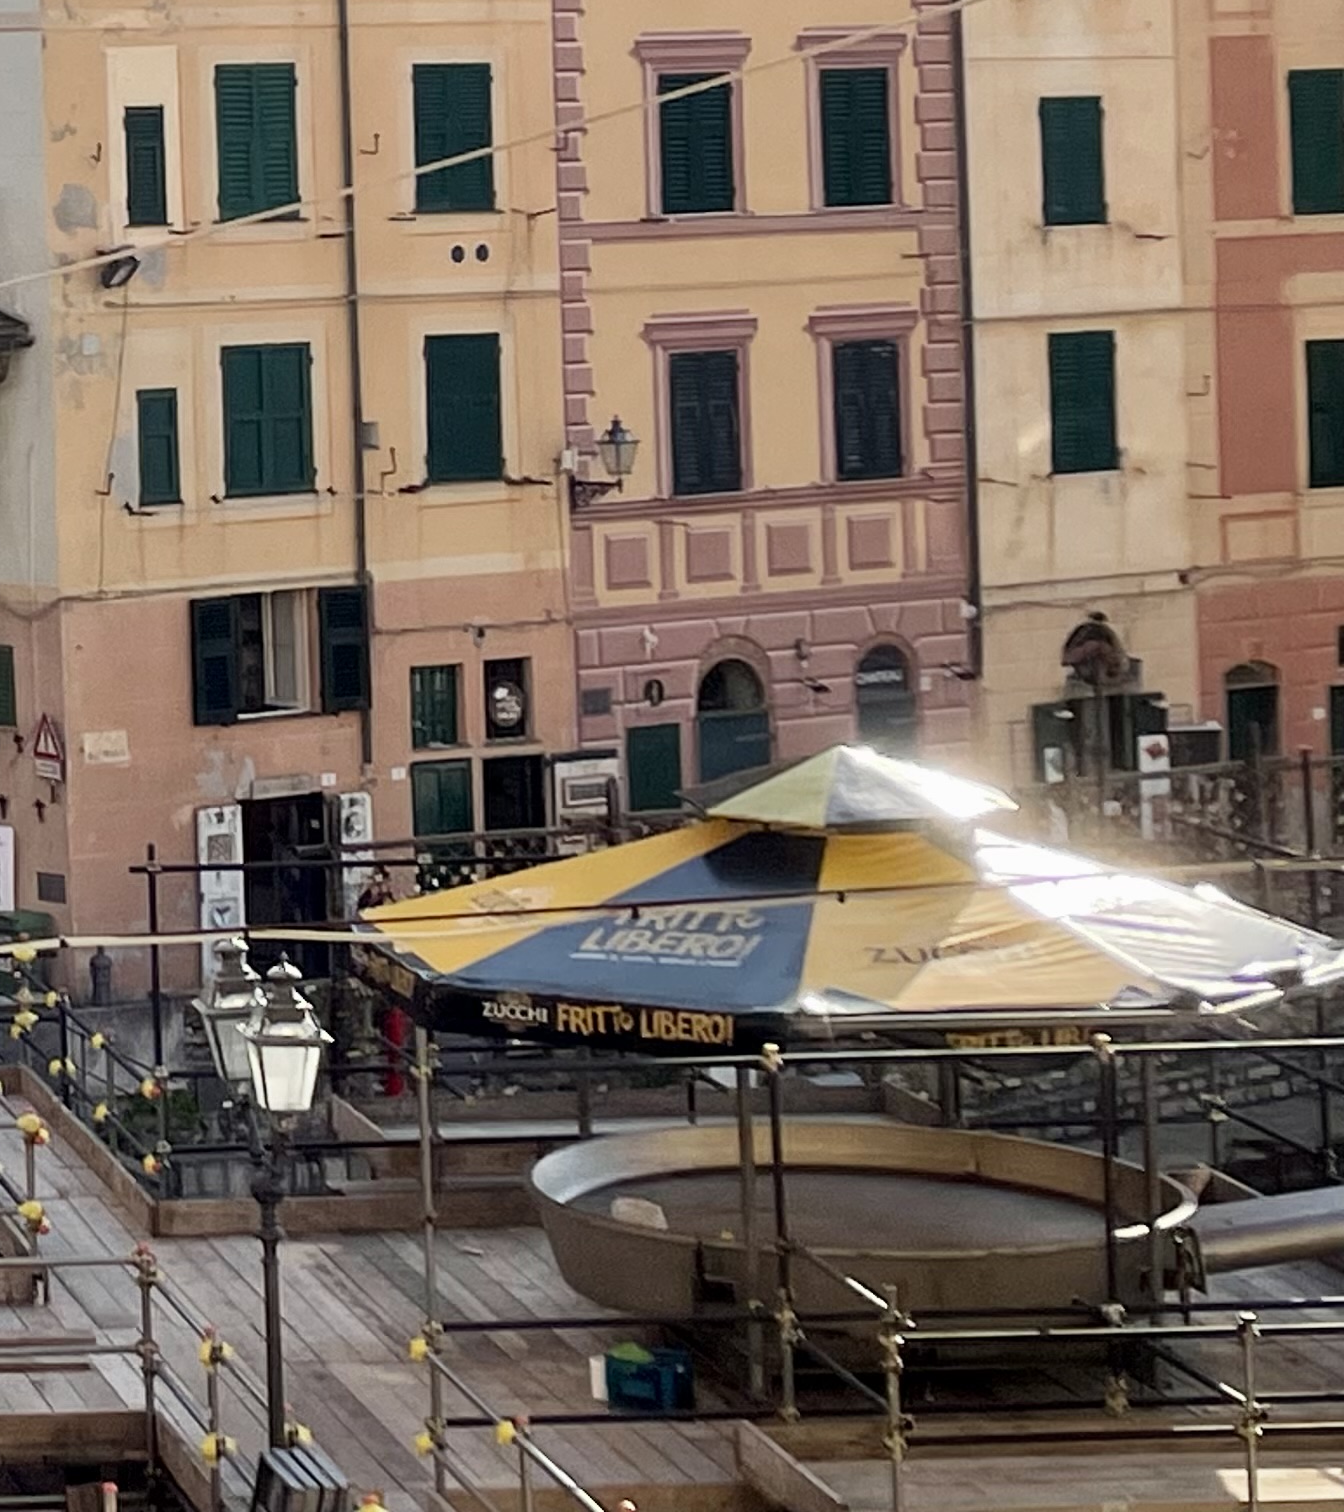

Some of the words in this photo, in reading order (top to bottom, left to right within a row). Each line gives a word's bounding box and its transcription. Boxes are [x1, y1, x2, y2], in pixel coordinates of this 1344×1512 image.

[578, 926, 768, 961] LIBERO!
[481, 1000, 549, 1024] ZUCCHI
[639, 1007, 736, 1046] LIBERO!
